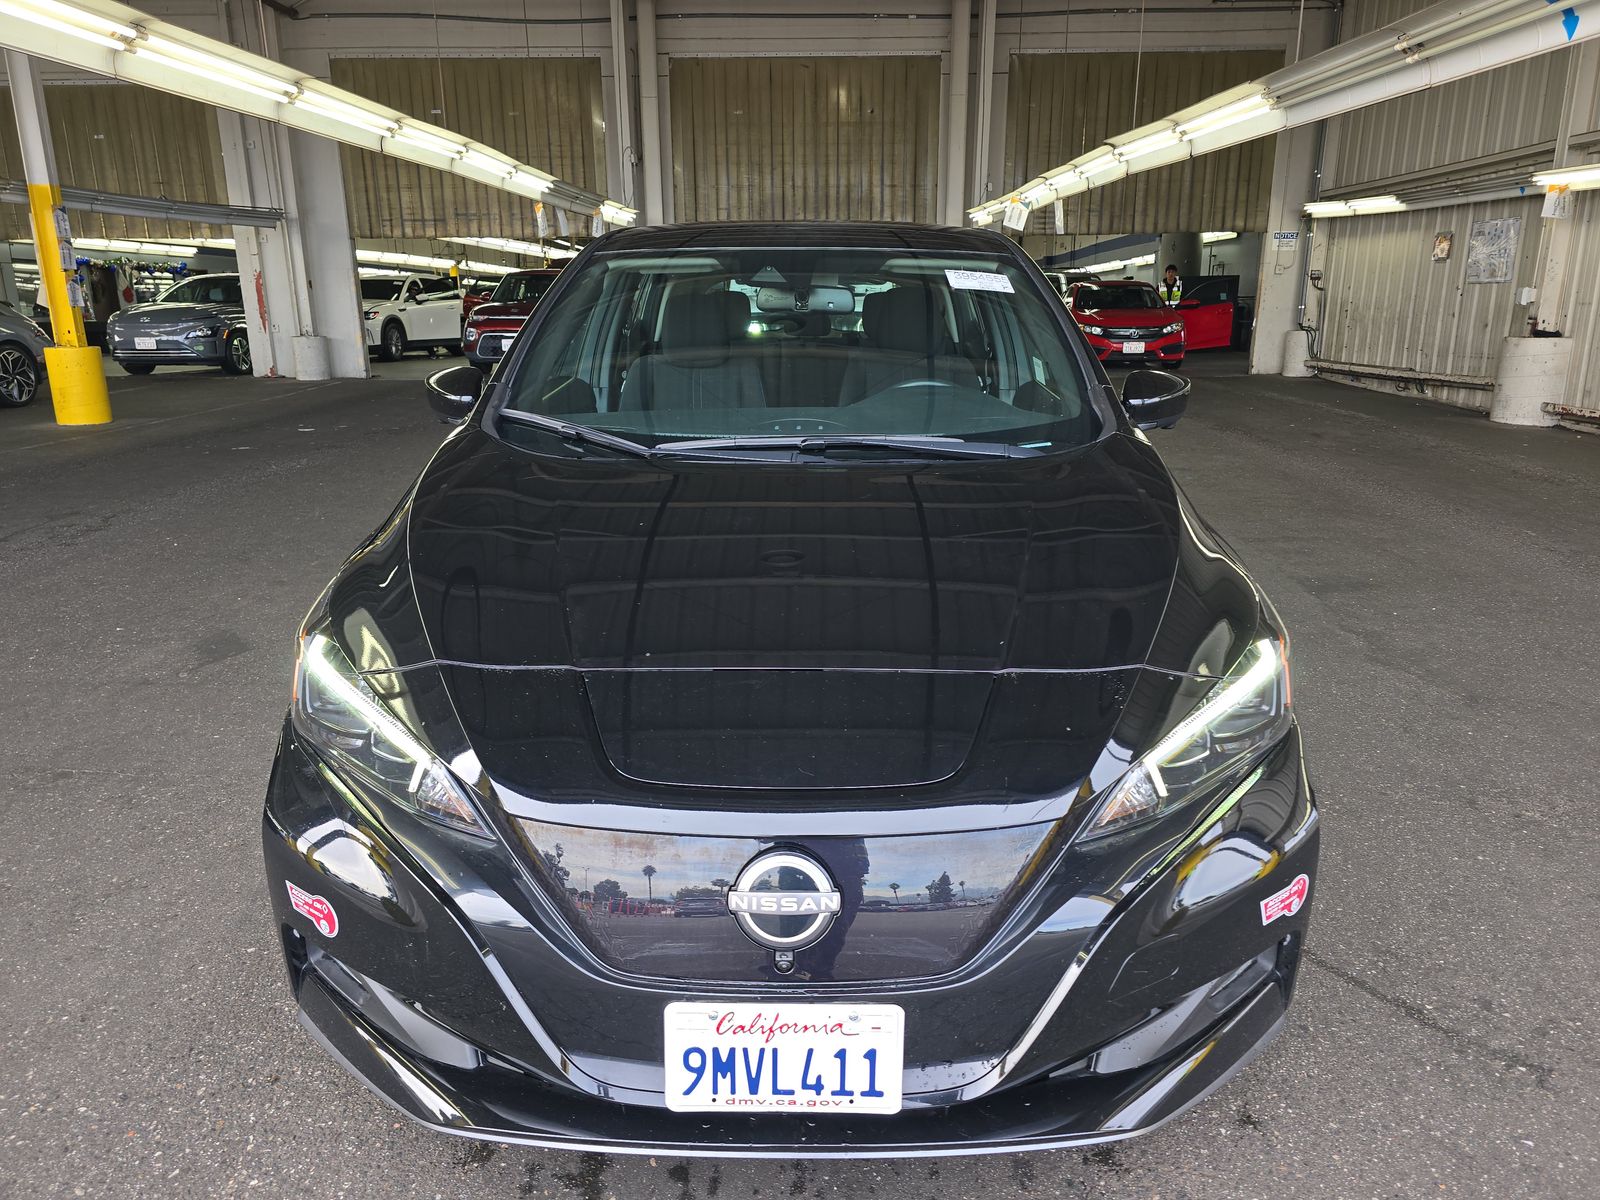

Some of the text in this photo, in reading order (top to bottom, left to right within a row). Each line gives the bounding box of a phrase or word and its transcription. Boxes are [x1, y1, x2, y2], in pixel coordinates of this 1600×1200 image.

[731, 896, 839, 911] NISSAN
[716, 1011, 859, 1043] California
[682, 1046, 884, 1098] 9MVL411
[725, 1098, 843, 1107] dmv.ca.gov
